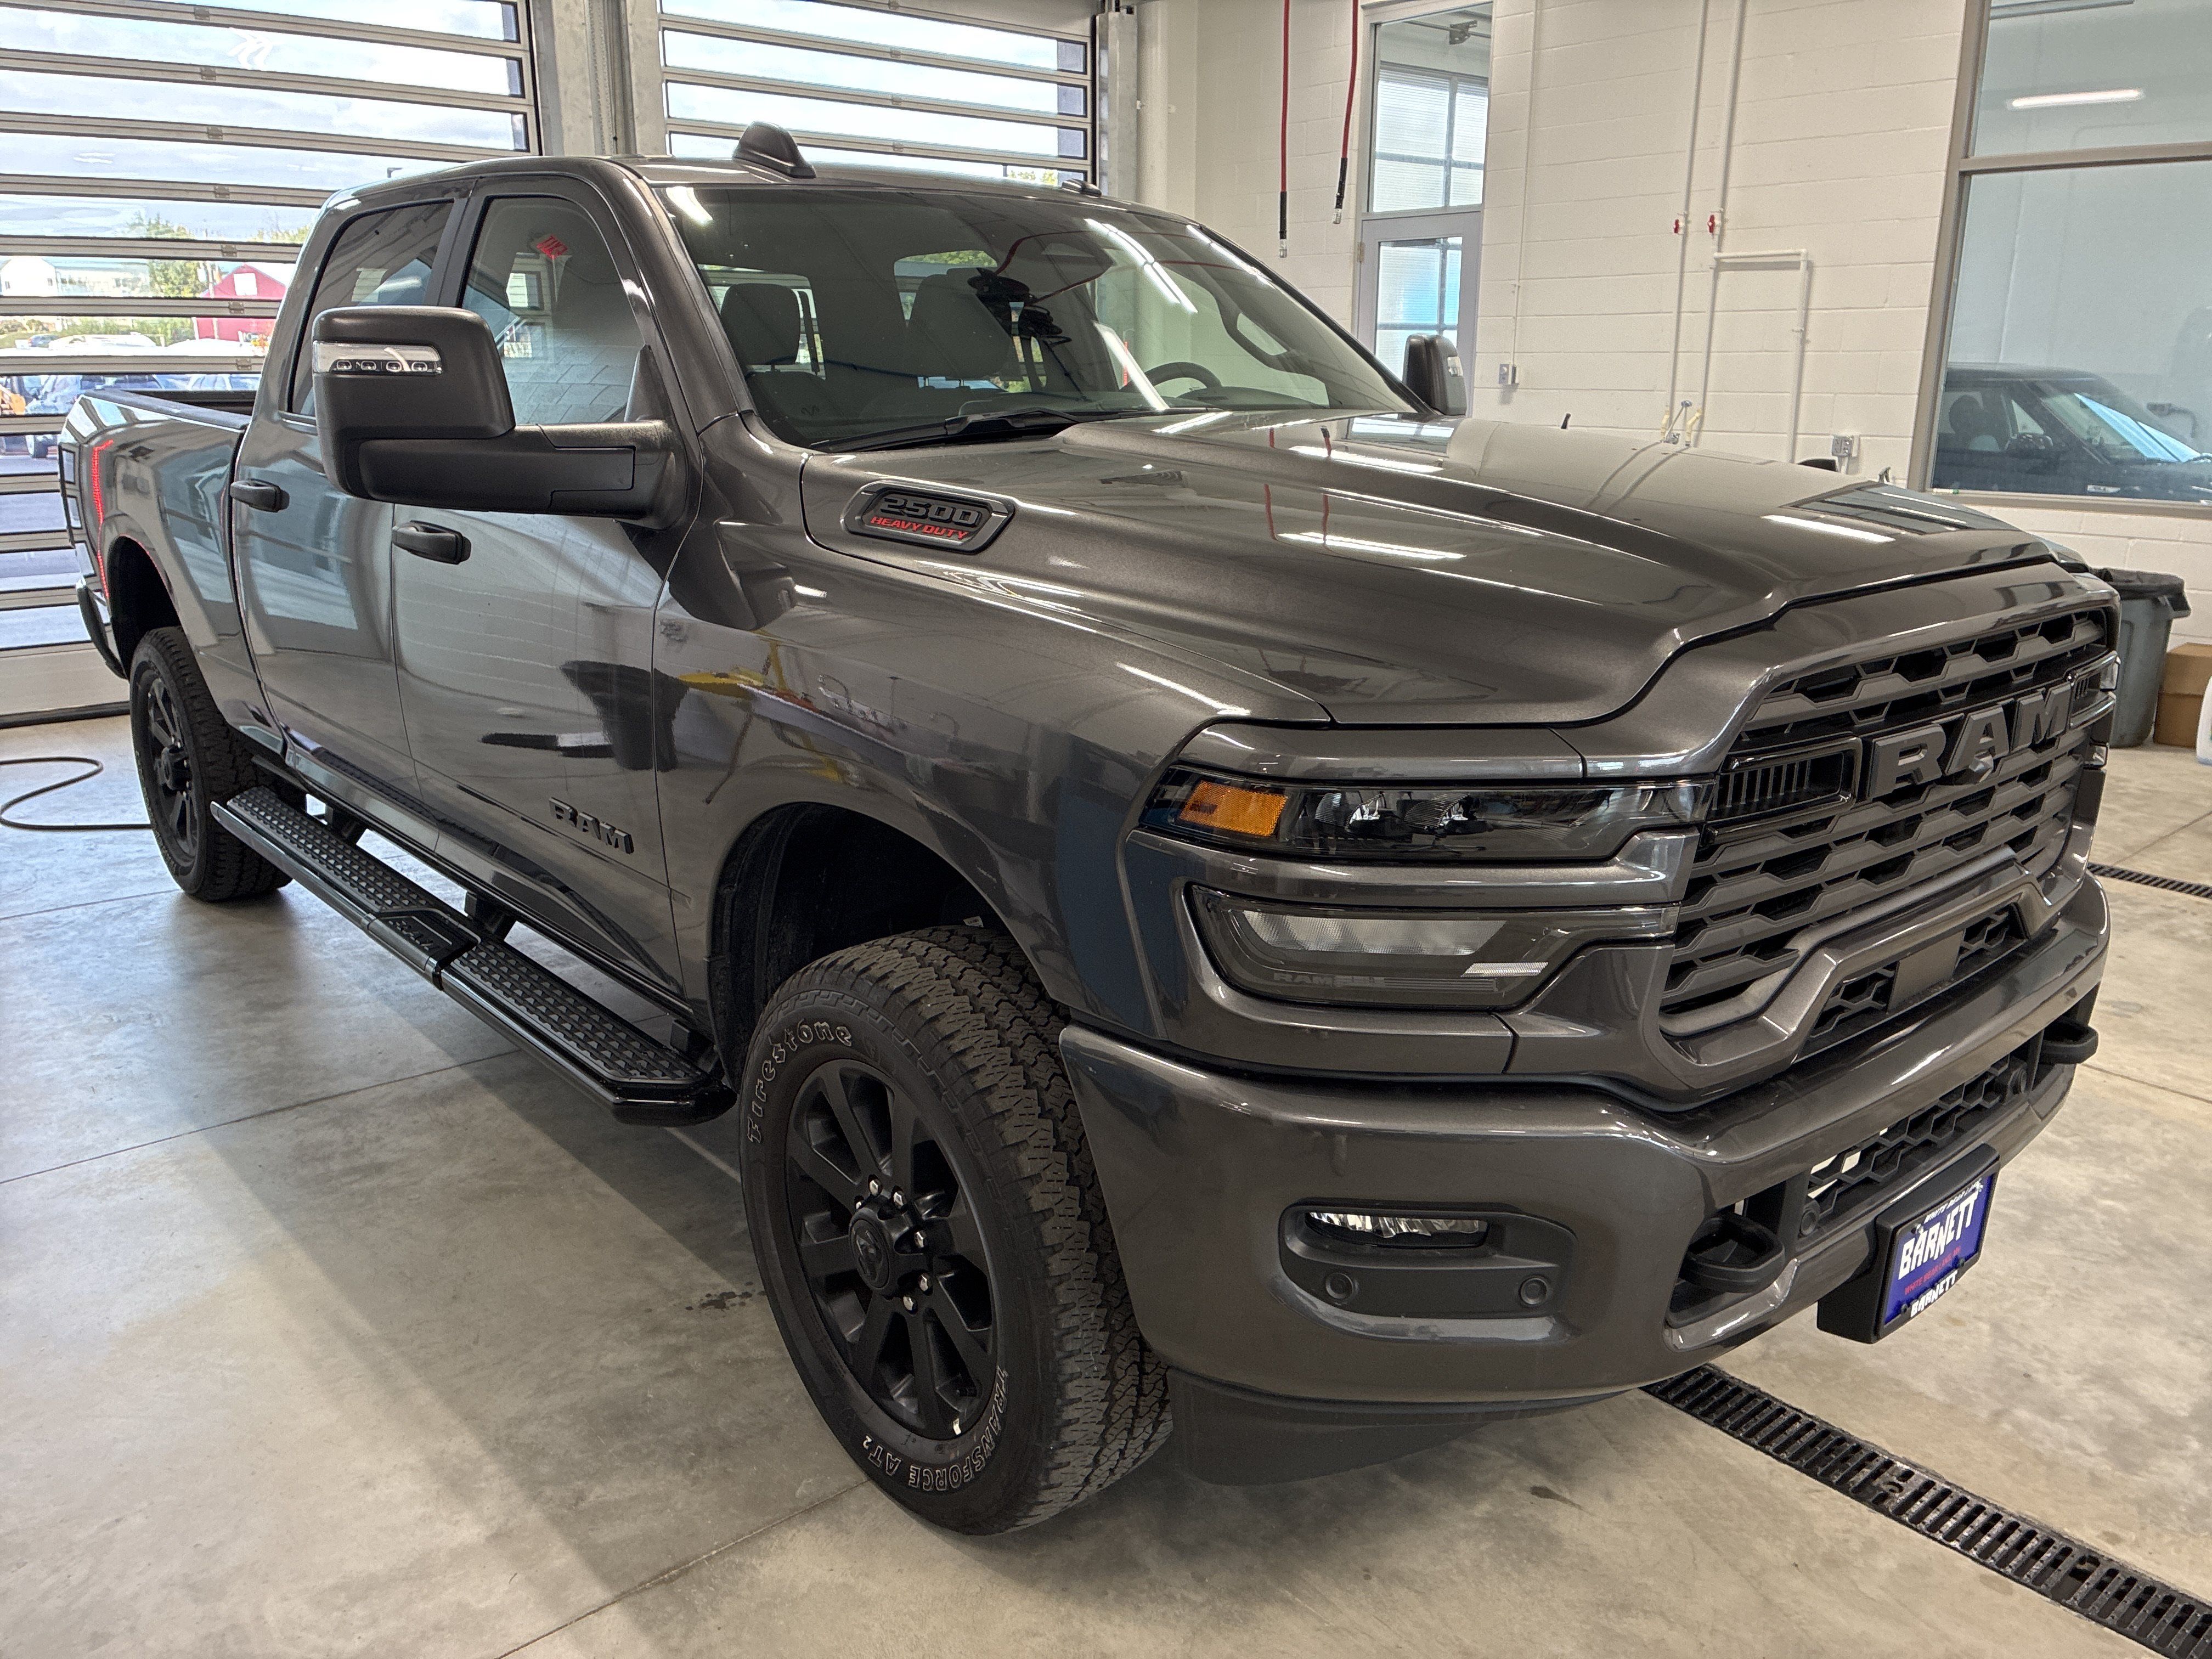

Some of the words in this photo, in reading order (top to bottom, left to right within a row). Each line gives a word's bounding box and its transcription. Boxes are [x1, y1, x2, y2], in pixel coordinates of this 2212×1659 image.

[870, 516, 924, 532] HEAVY
[922, 524, 969, 540] DUTY
[880, 497, 981, 527] 2500
[1870, 684, 2071, 797] RAM
[549, 797, 634, 854] RAM
[1273, 973, 1334, 987] RAM
[1898, 1191, 1978, 1280] BARNETT
[1910, 1270, 1957, 1318] BARNETT
[908, 1365, 1009, 1491] TRANSFORCE
